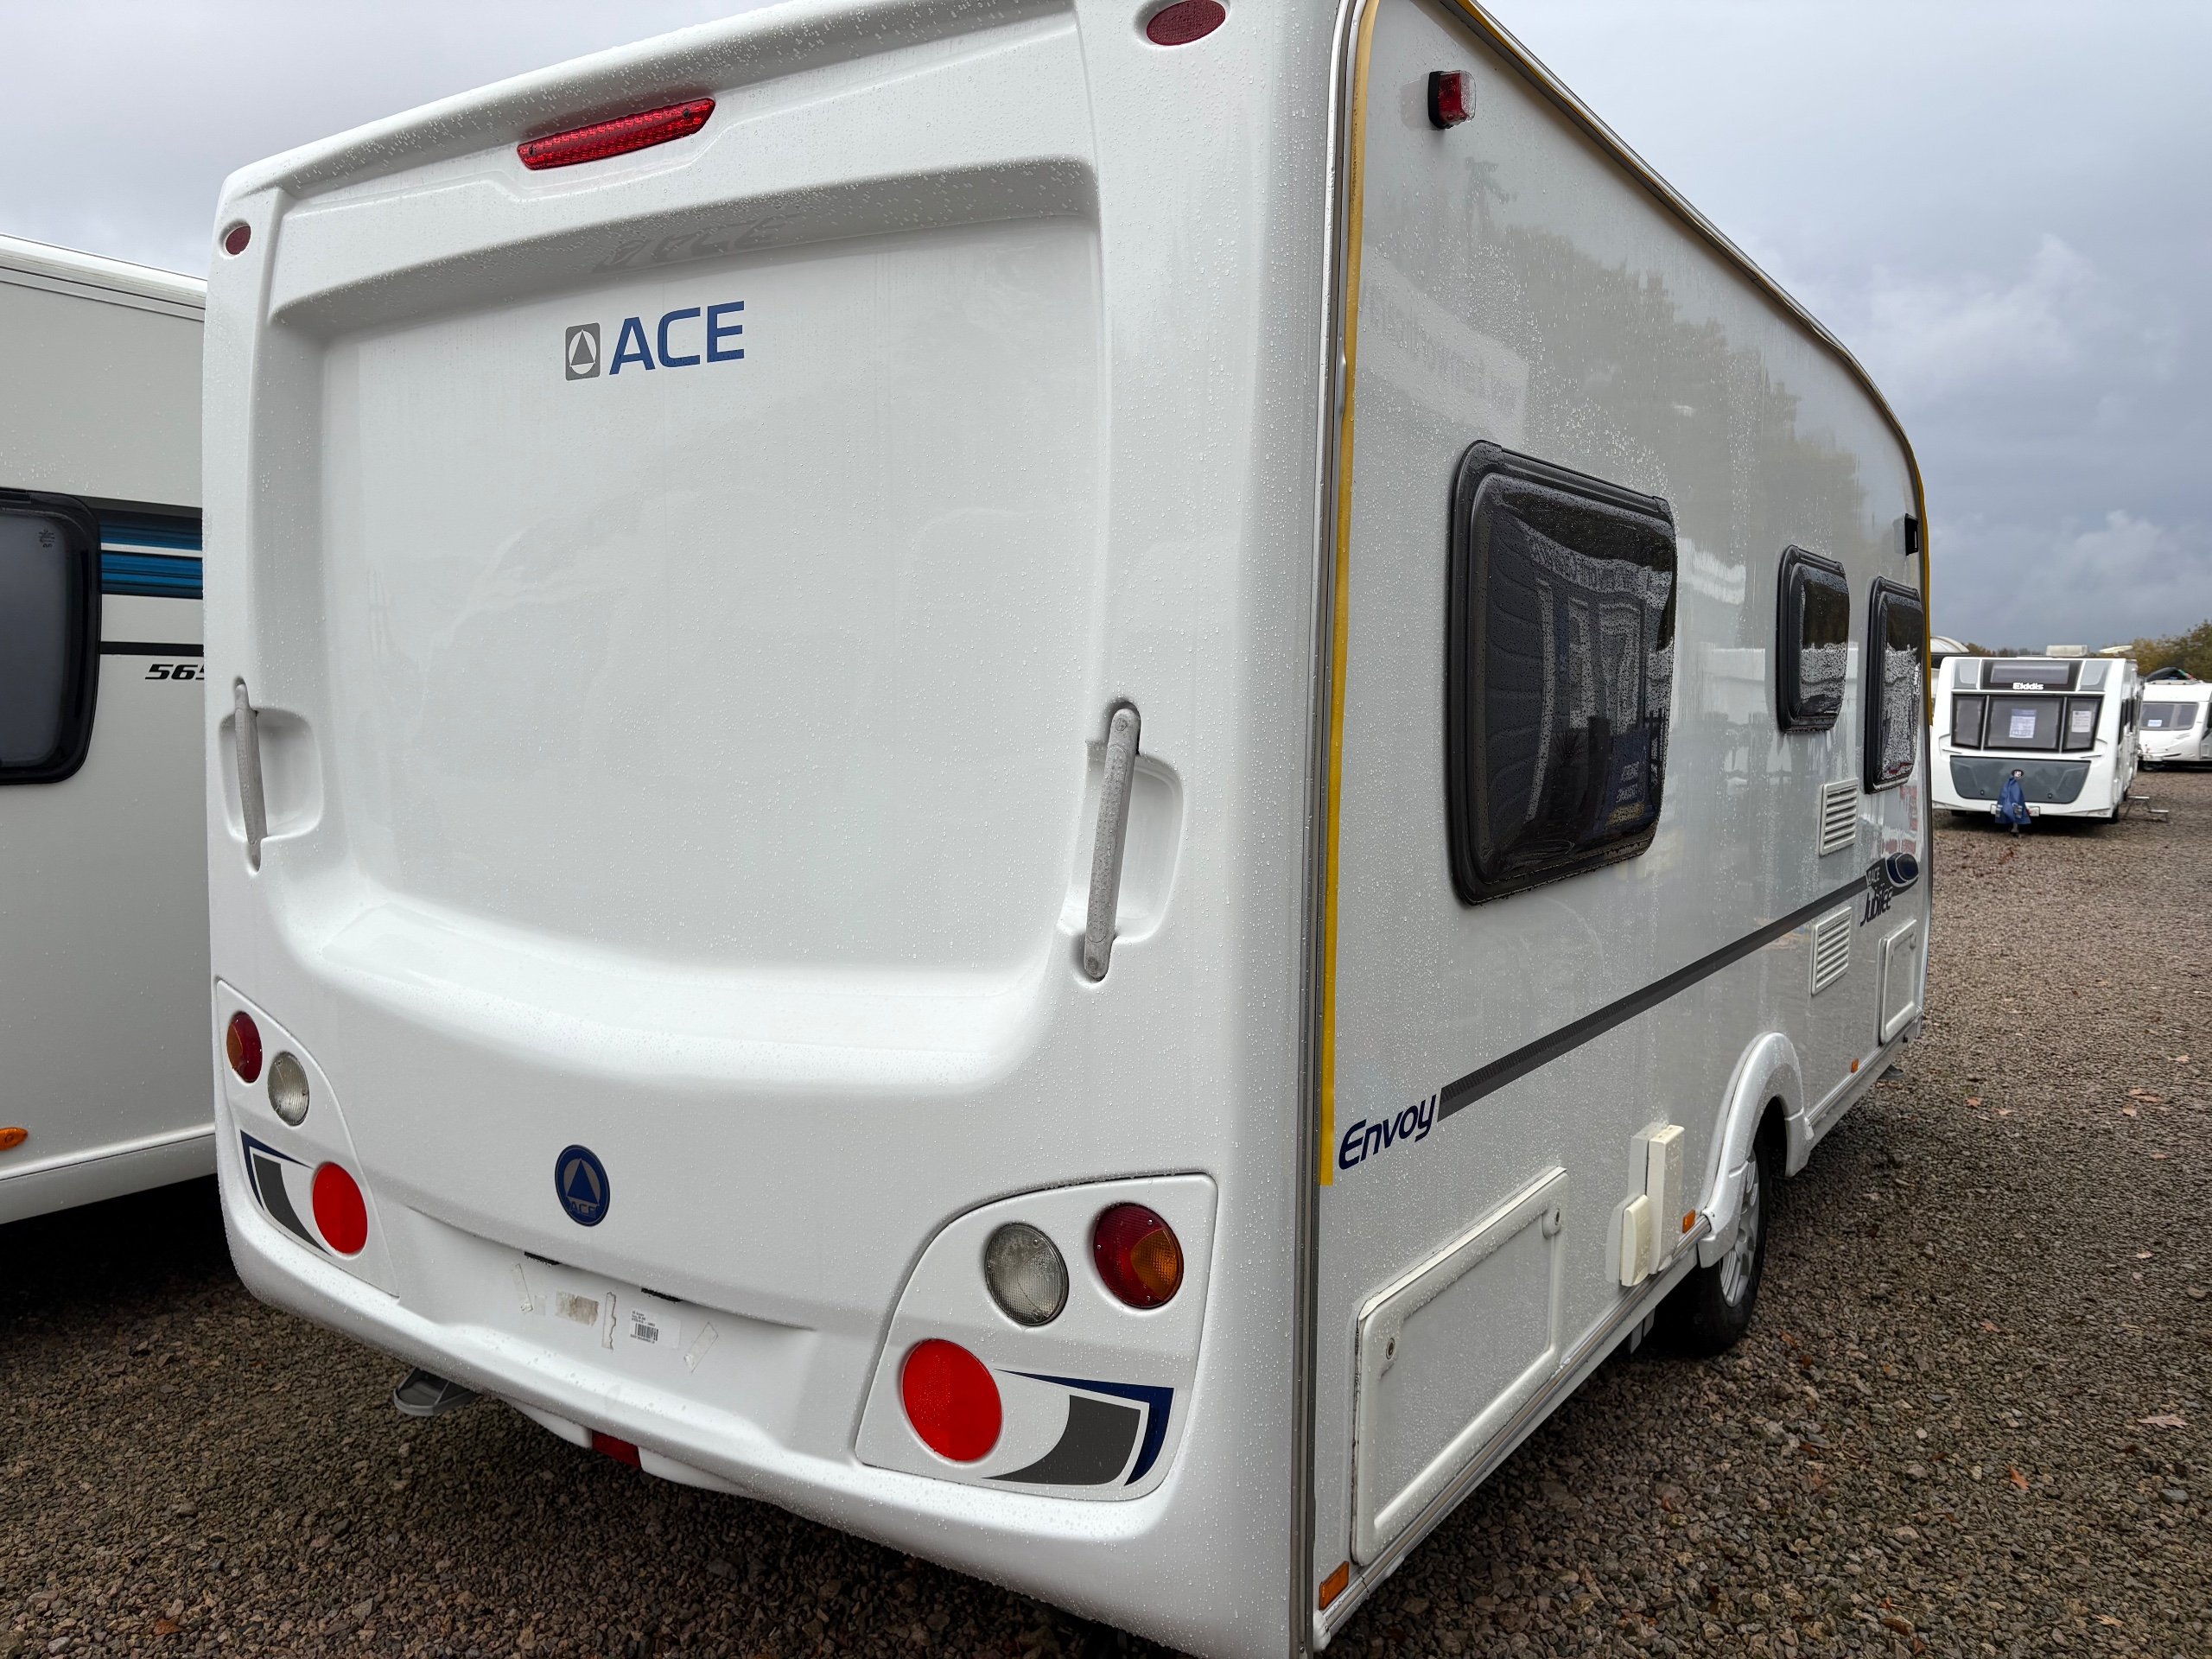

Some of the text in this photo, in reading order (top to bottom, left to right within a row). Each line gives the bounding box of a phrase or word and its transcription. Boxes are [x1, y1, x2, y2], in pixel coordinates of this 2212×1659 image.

[608, 300, 745, 375] ACE
[1338, 1094, 1437, 1170] Envoy
[569, 1200, 597, 1218] ACE
